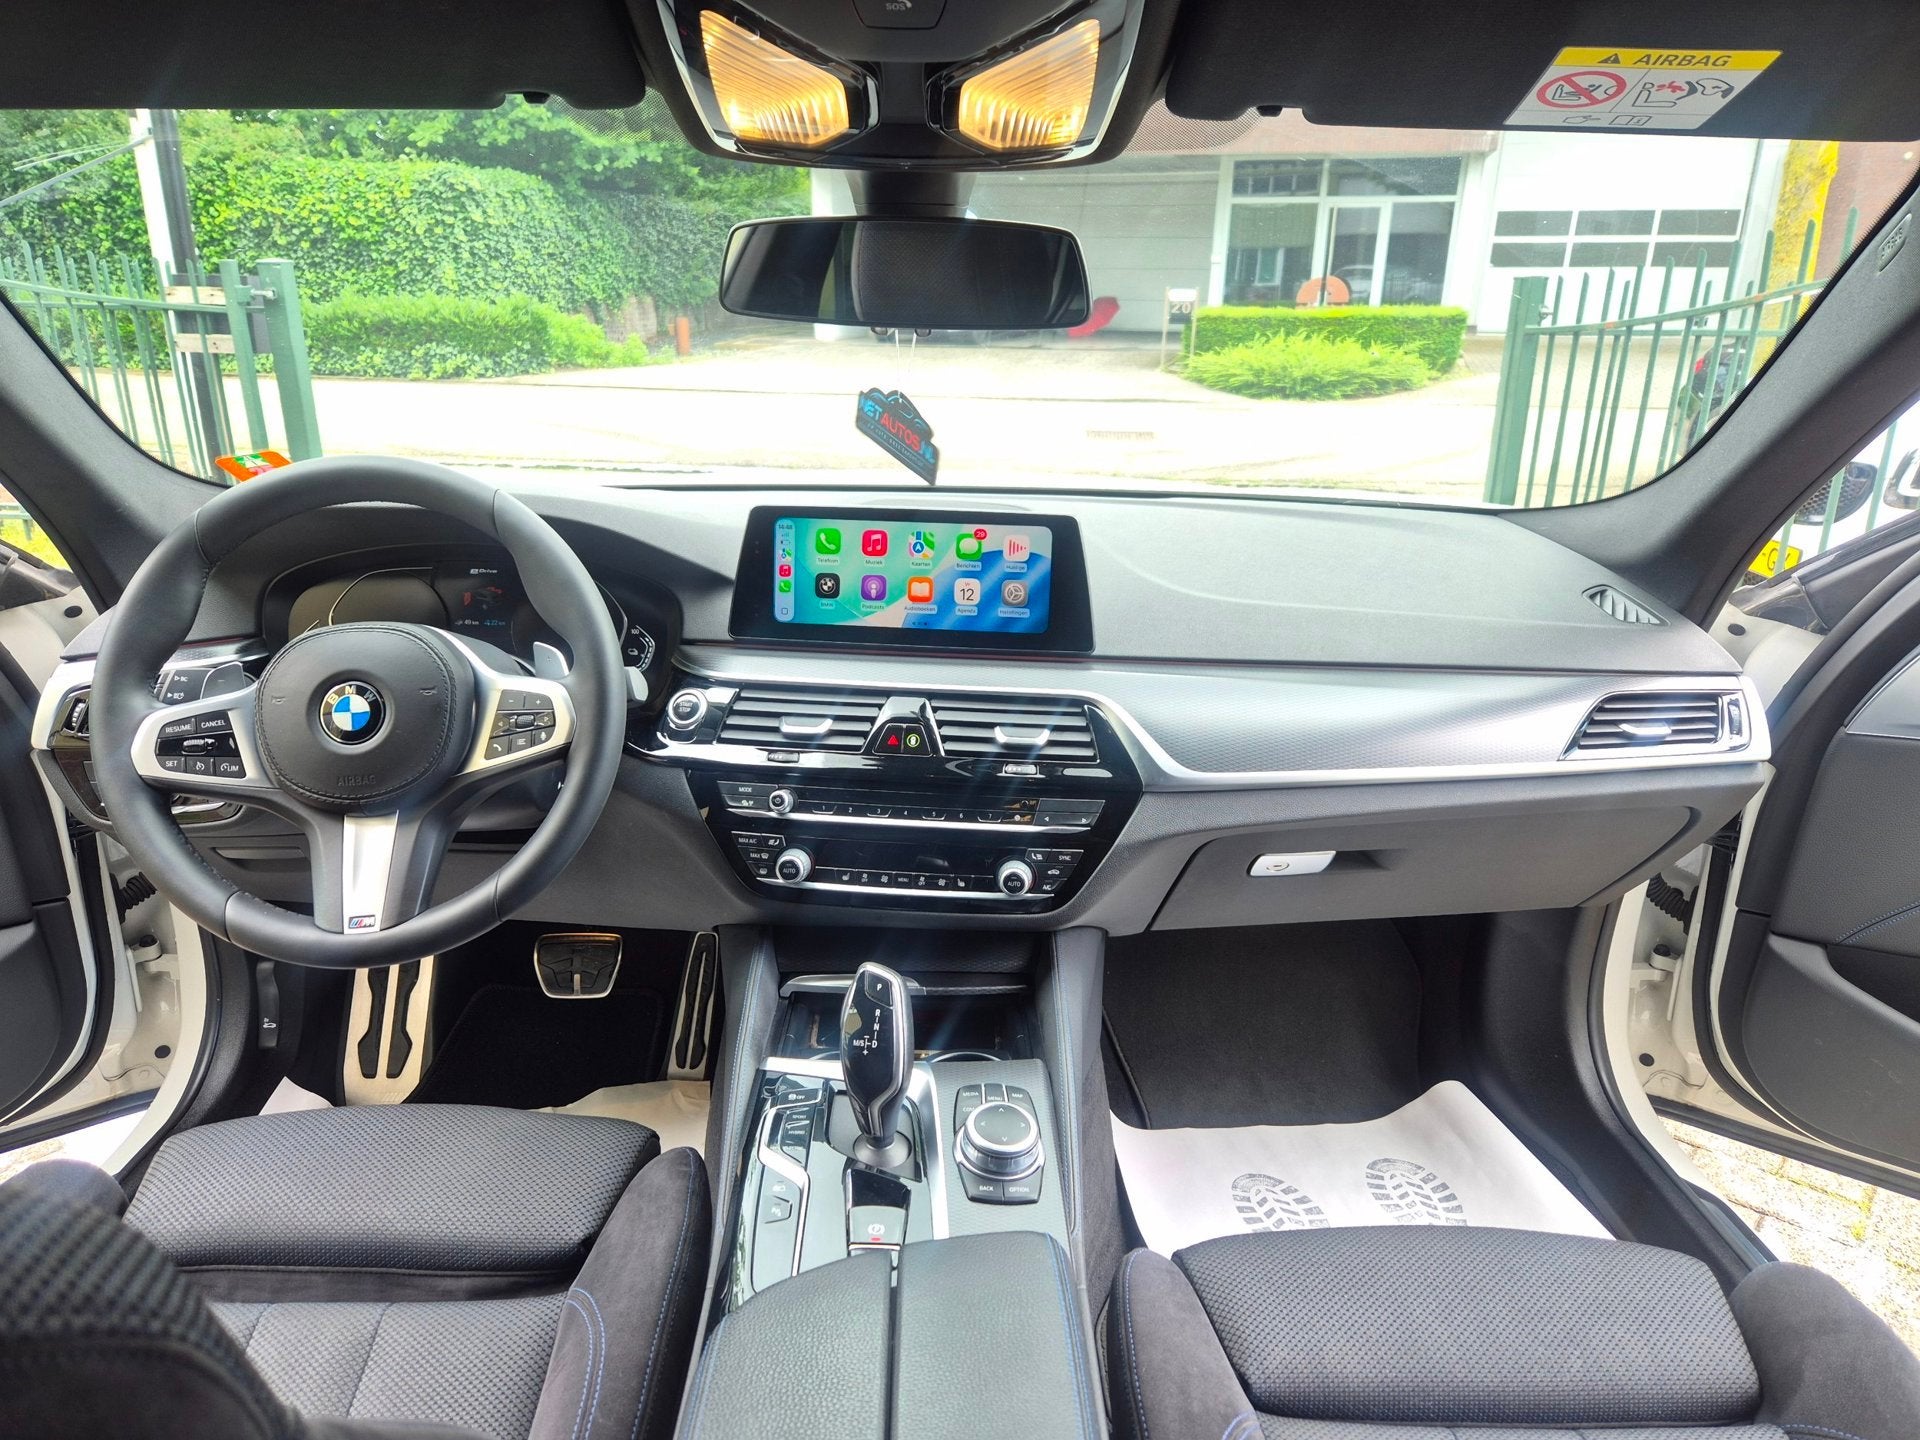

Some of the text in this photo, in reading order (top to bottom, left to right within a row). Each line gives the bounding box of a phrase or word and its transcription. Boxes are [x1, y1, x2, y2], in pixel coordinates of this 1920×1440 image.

[886, 2, 906, 10] SOS
[1633, 54, 1732, 67] AIRBAG
[1171, 303, 1191, 314] 20
[960, 588, 975, 601] 12
[327, 685, 377, 705] BMW
[165, 724, 192, 733] RESUME
[201, 720, 226, 729] CANCEL
[337, 774, 377, 787] AIRBAG
[1007, 880, 1021, 888] AUTO
[876, 983, 883, 991] P
[874, 1008, 881, 1017] R
[873, 1022, 880, 1031] N
[852, 1039, 878, 1048] M/S D
